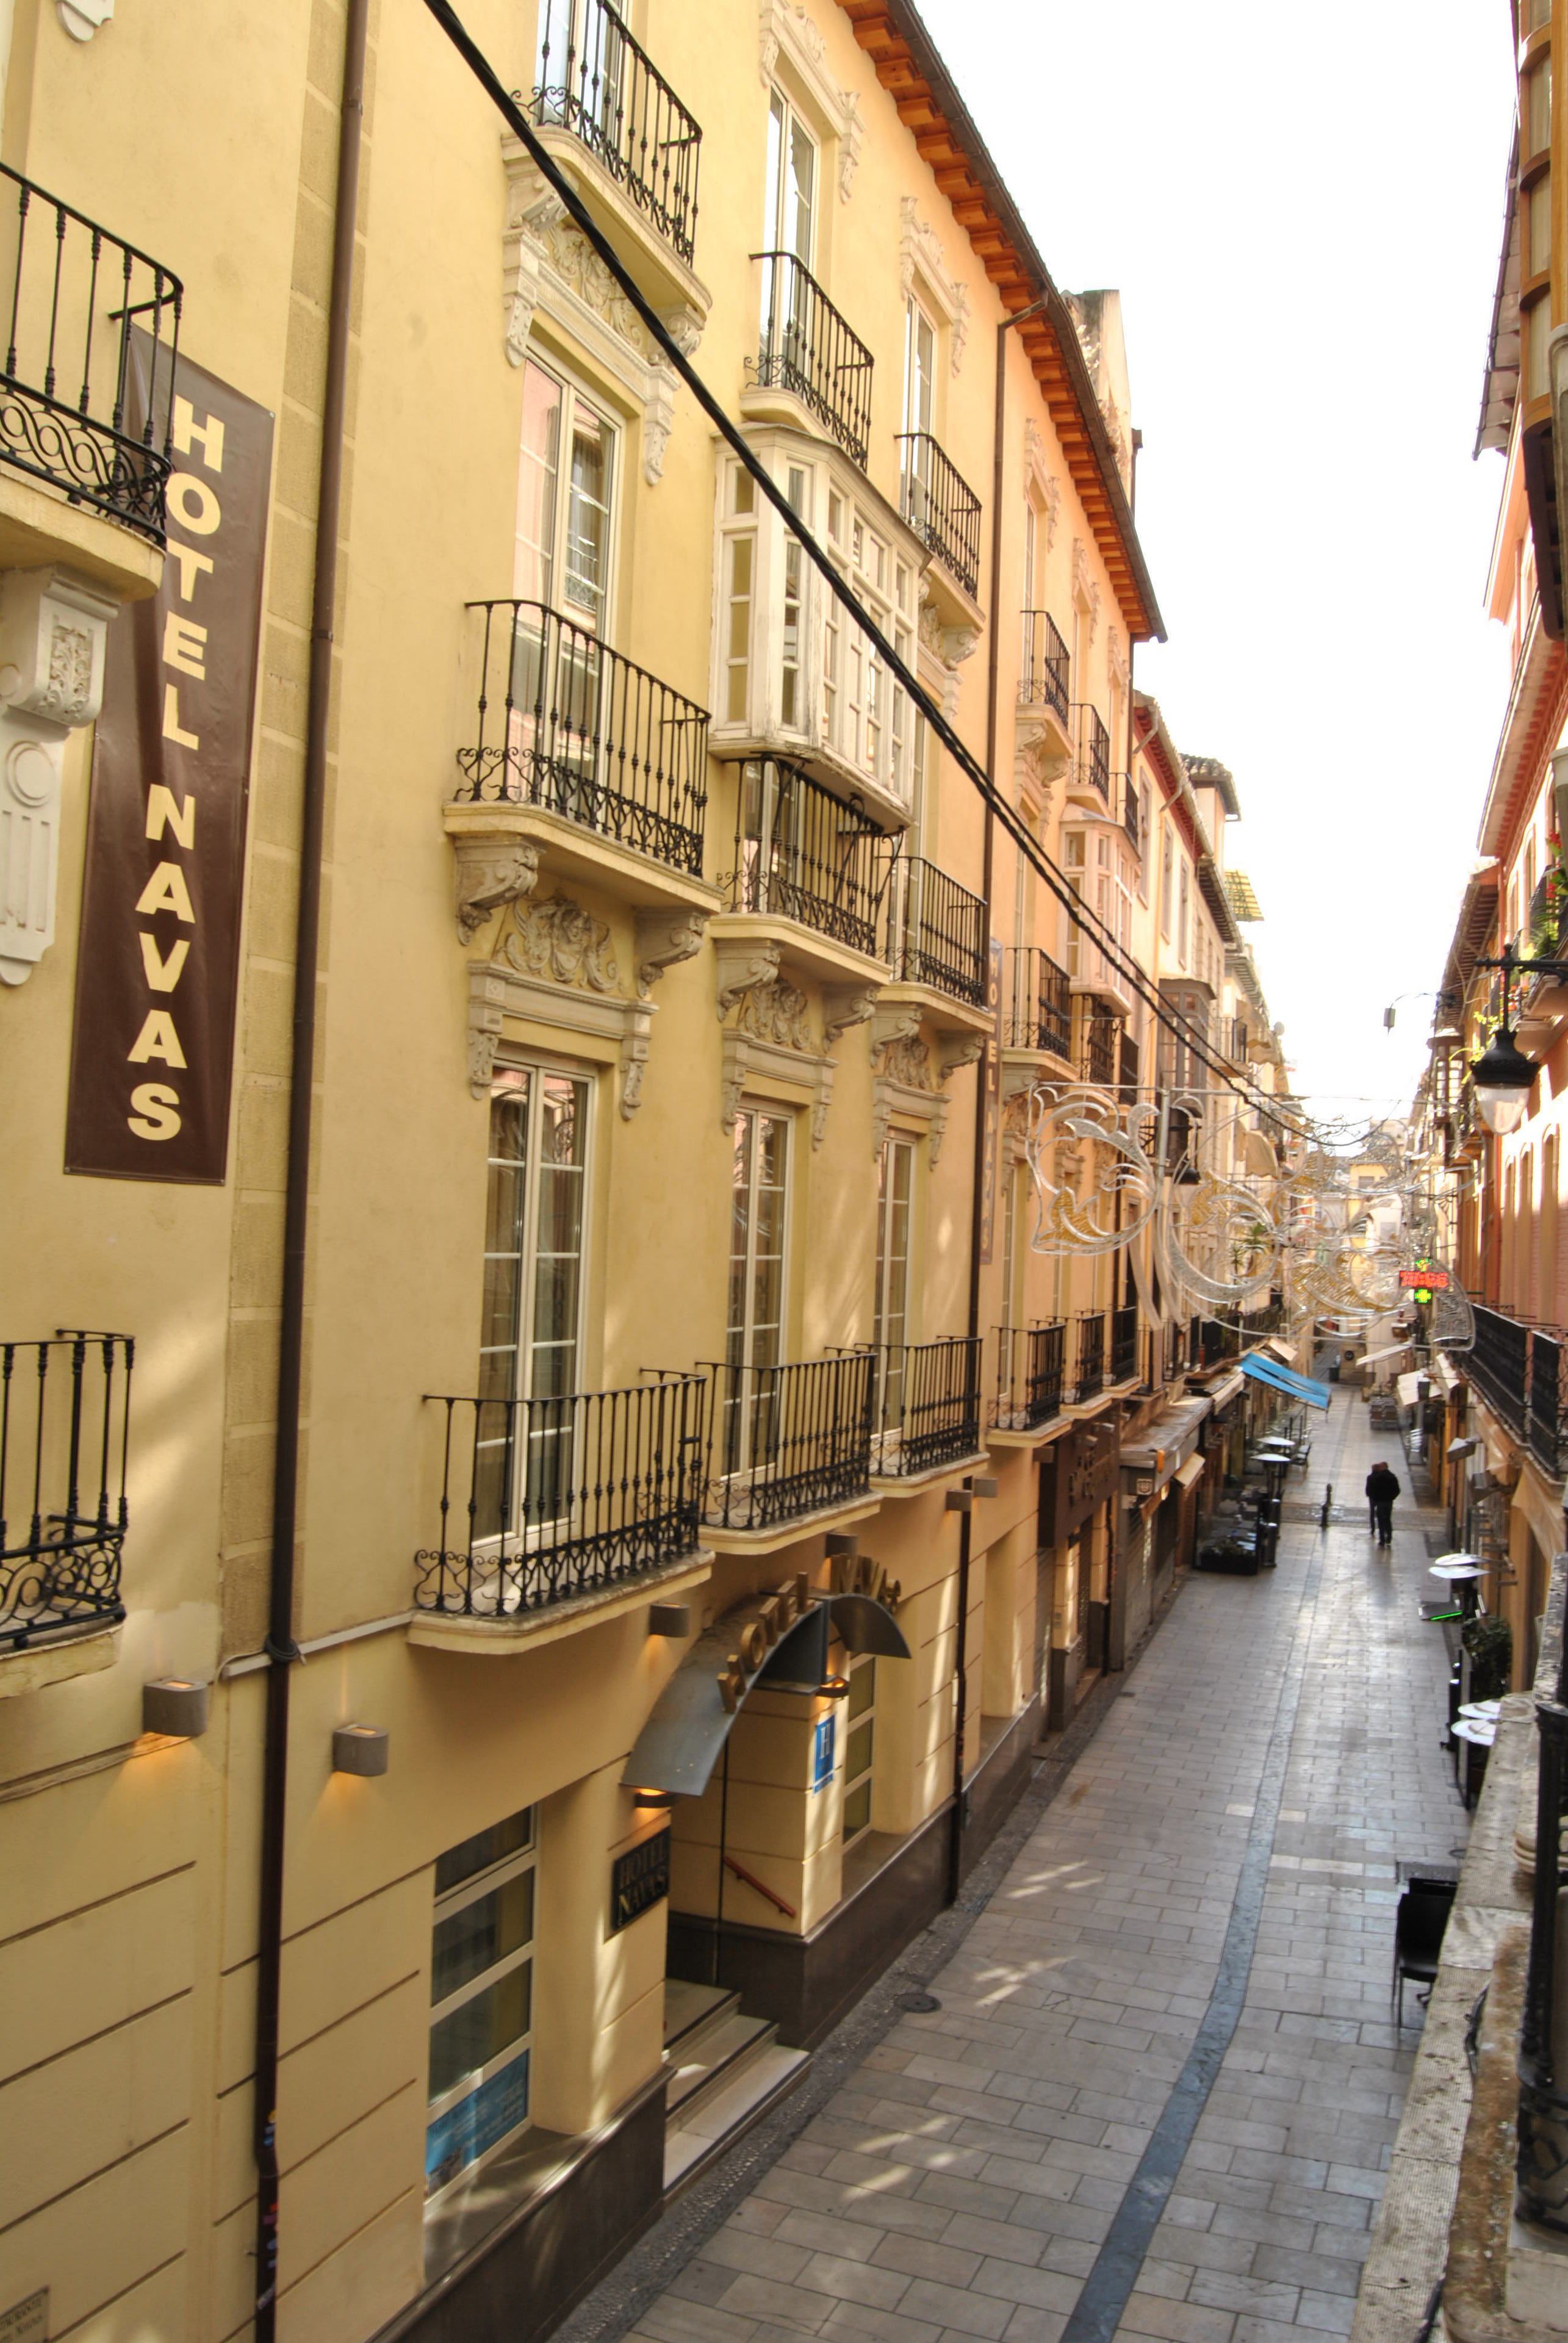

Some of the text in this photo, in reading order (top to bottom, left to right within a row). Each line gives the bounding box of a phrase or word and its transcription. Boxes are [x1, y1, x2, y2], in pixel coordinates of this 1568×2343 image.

[162, 395, 225, 750] HOTEL
[126, 784, 196, 1141] NAVAS
[717, 1572, 819, 1715] HOTEL
[617, 1865, 666, 1926] NAVAS
[619, 1835, 667, 1890] HOTEL
